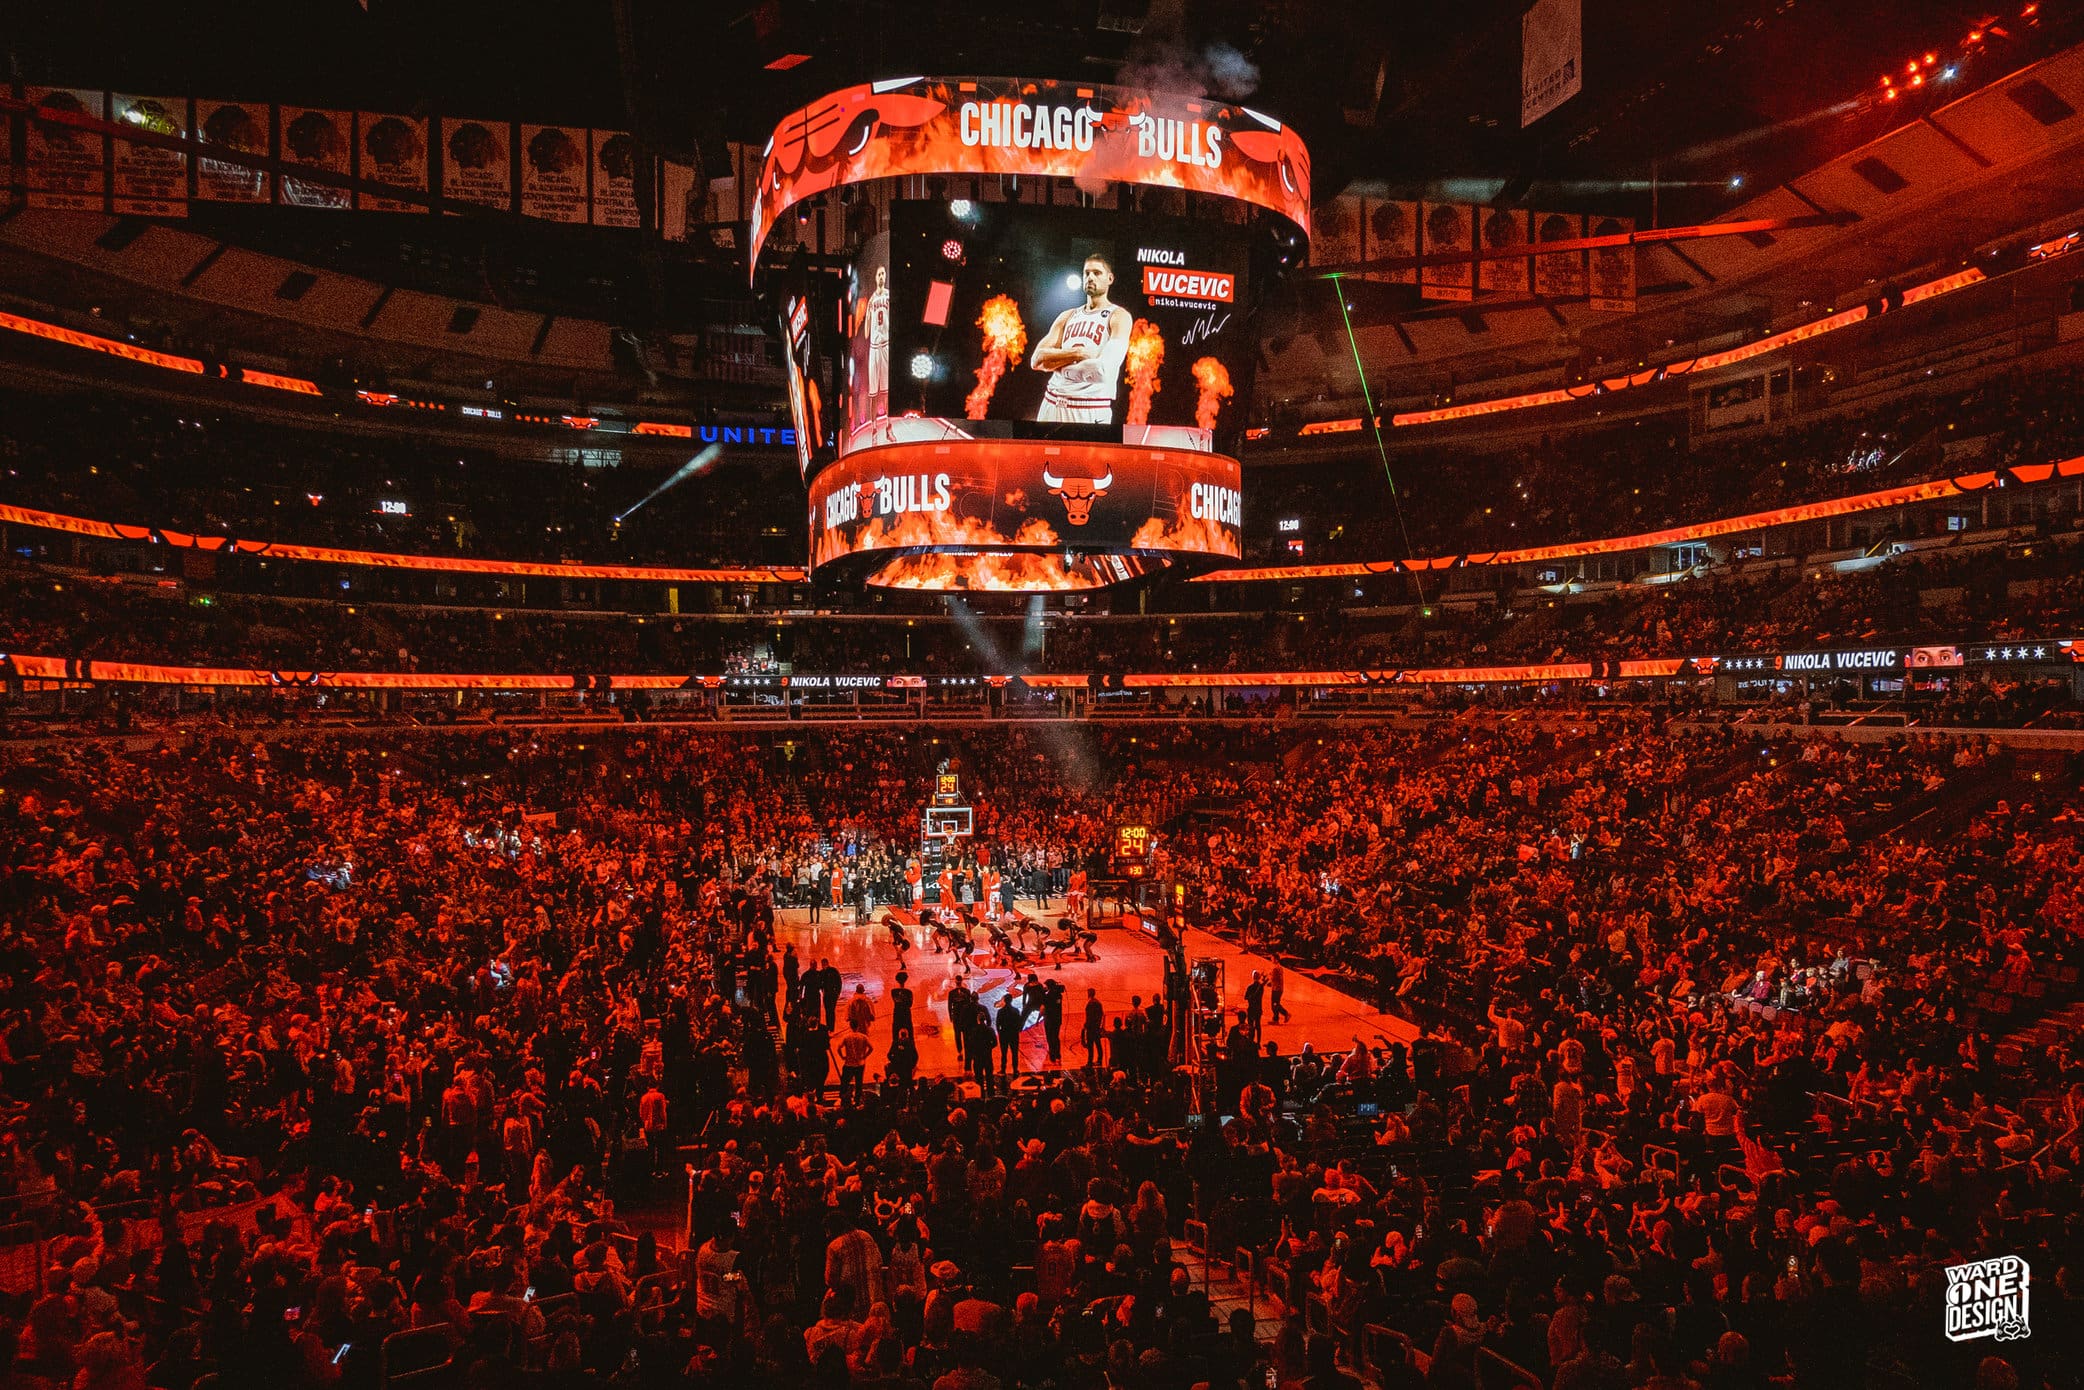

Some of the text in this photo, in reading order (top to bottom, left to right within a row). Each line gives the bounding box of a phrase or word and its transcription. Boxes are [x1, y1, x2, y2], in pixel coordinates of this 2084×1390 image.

[960, 102, 1222, 168] CHICAGO BULLS
[1137, 248, 1185, 265] NIKOLA
[1148, 271, 1230, 298] VUCEVIC
[1148, 295, 1217, 311] @nikolavucevic
[1063, 320, 1105, 346] BULLS
[826, 473, 950, 530] CHICAGO BULLS
[1775, 650, 1896, 670] 9 NIKOLA VUCEVIC
[781, 676, 881, 687] 9 NIKOLA VUCEVIC
[941, 782, 955, 793] 24
[1121, 827, 1146, 839] 12:00
[1121, 838, 1143, 855] 24
